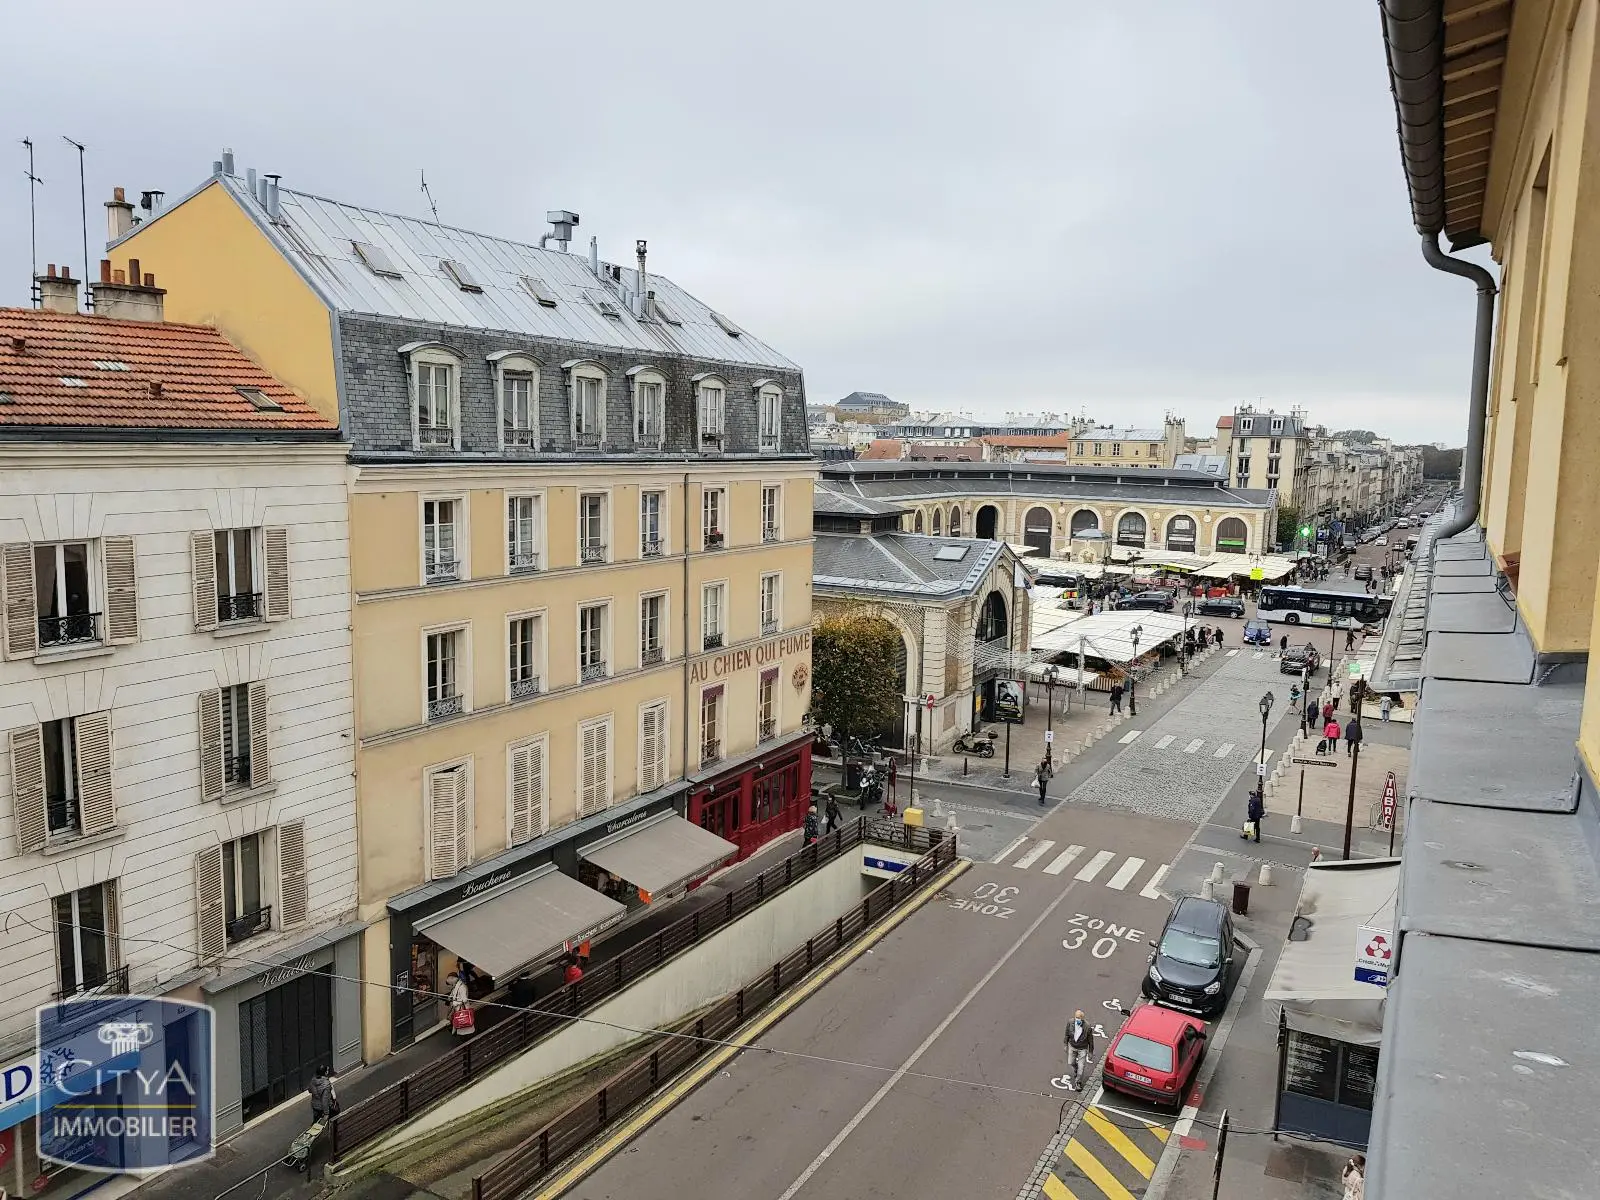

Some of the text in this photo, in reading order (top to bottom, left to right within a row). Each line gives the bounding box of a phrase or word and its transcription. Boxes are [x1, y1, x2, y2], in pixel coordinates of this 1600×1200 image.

[690, 633, 810, 684] AU CHIEN QUI FUME
[1384, 779, 1394, 825] TABAC
[462, 869, 512, 898] Boucherie
[973, 882, 1020, 904] 30
[949, 898, 1017, 919] ZONE
[1062, 928, 1118, 959] 30
[1067, 913, 1146, 943] ZONE
[258, 955, 315, 988] Volailles
[0, 1065, 33, 1105] D
